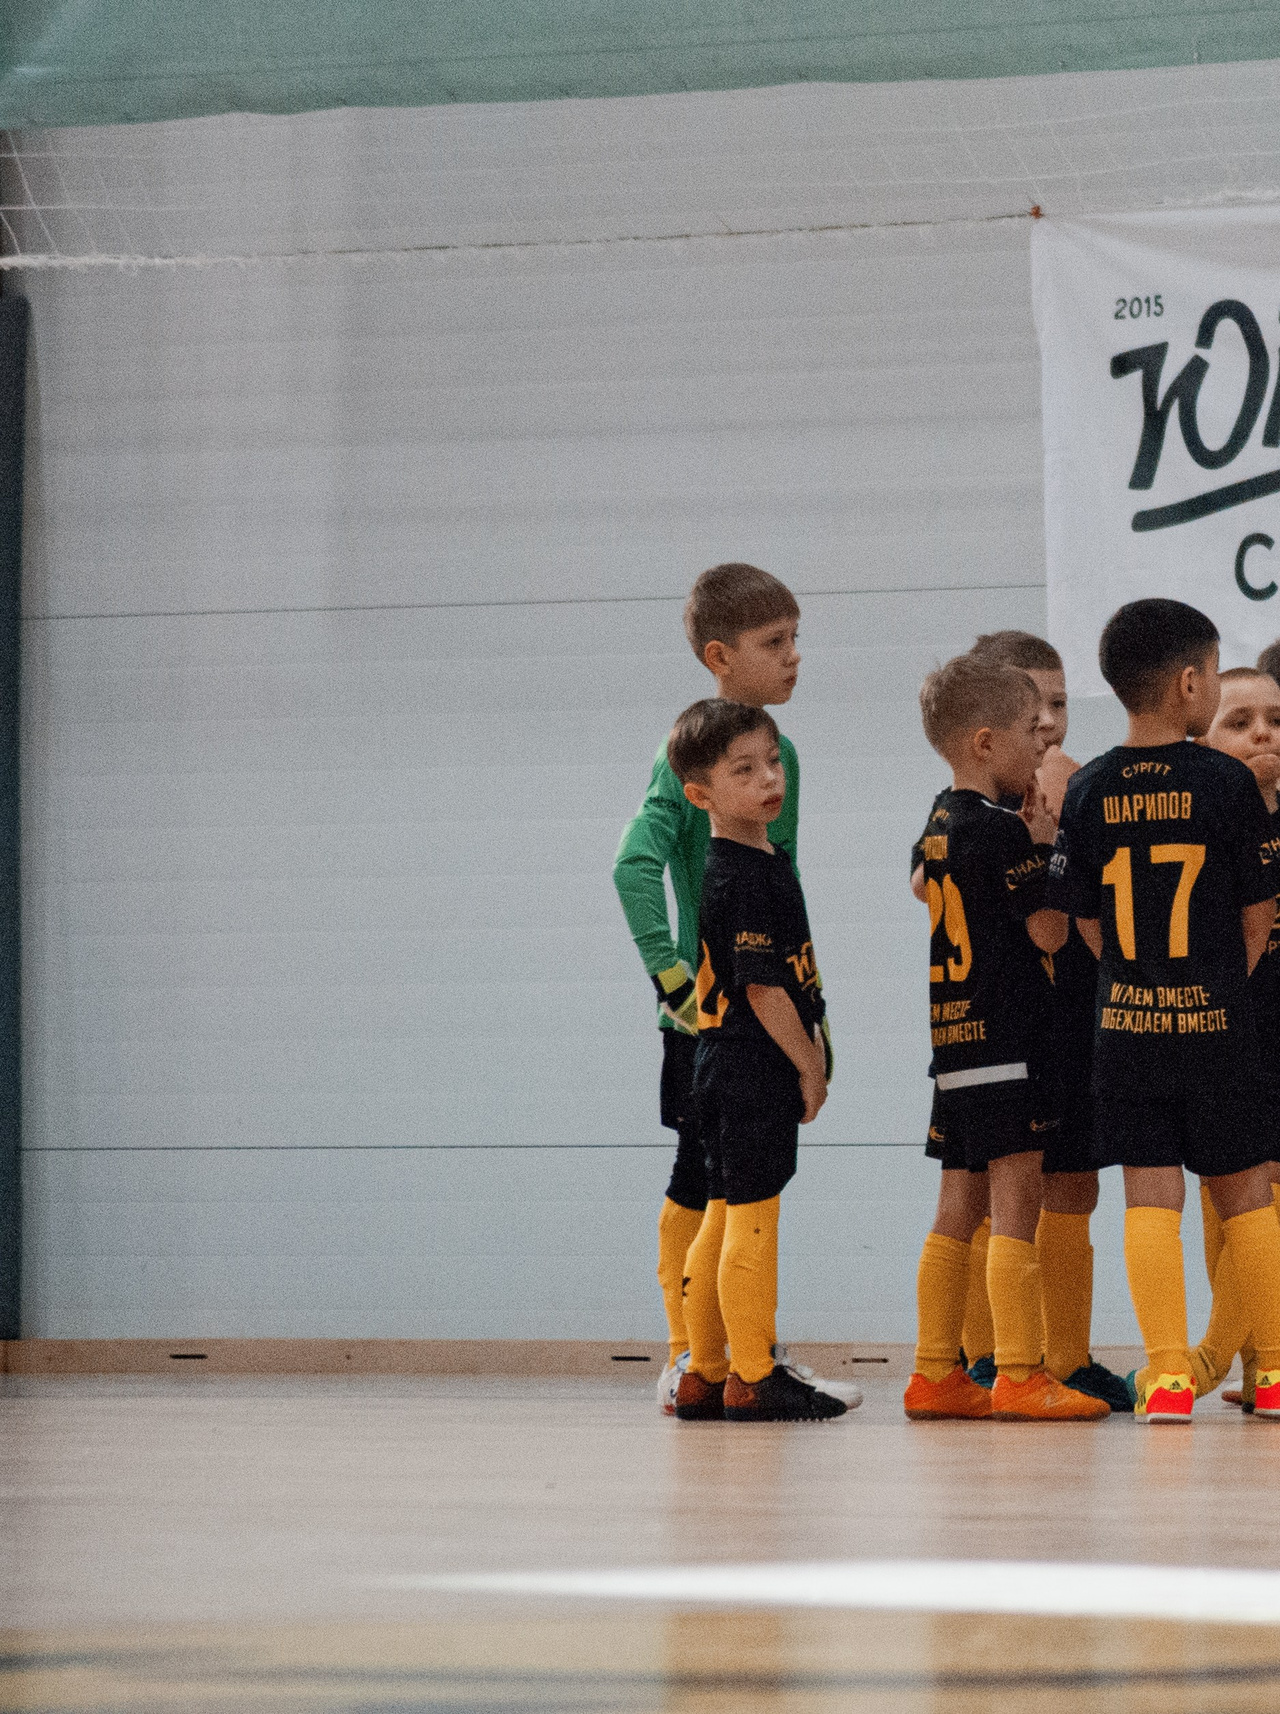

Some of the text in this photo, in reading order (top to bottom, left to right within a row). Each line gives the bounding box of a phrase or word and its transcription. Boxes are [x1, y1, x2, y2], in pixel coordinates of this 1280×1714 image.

[1113, 295, 1166, 320] 2015
[1121, 761, 1173, 779] СУРГУТ
[1103, 791, 1193, 824] ШАРИПОВ
[1101, 842, 1207, 961] 17
[1176, 1008, 1230, 1035] ВМЕСТЕ
